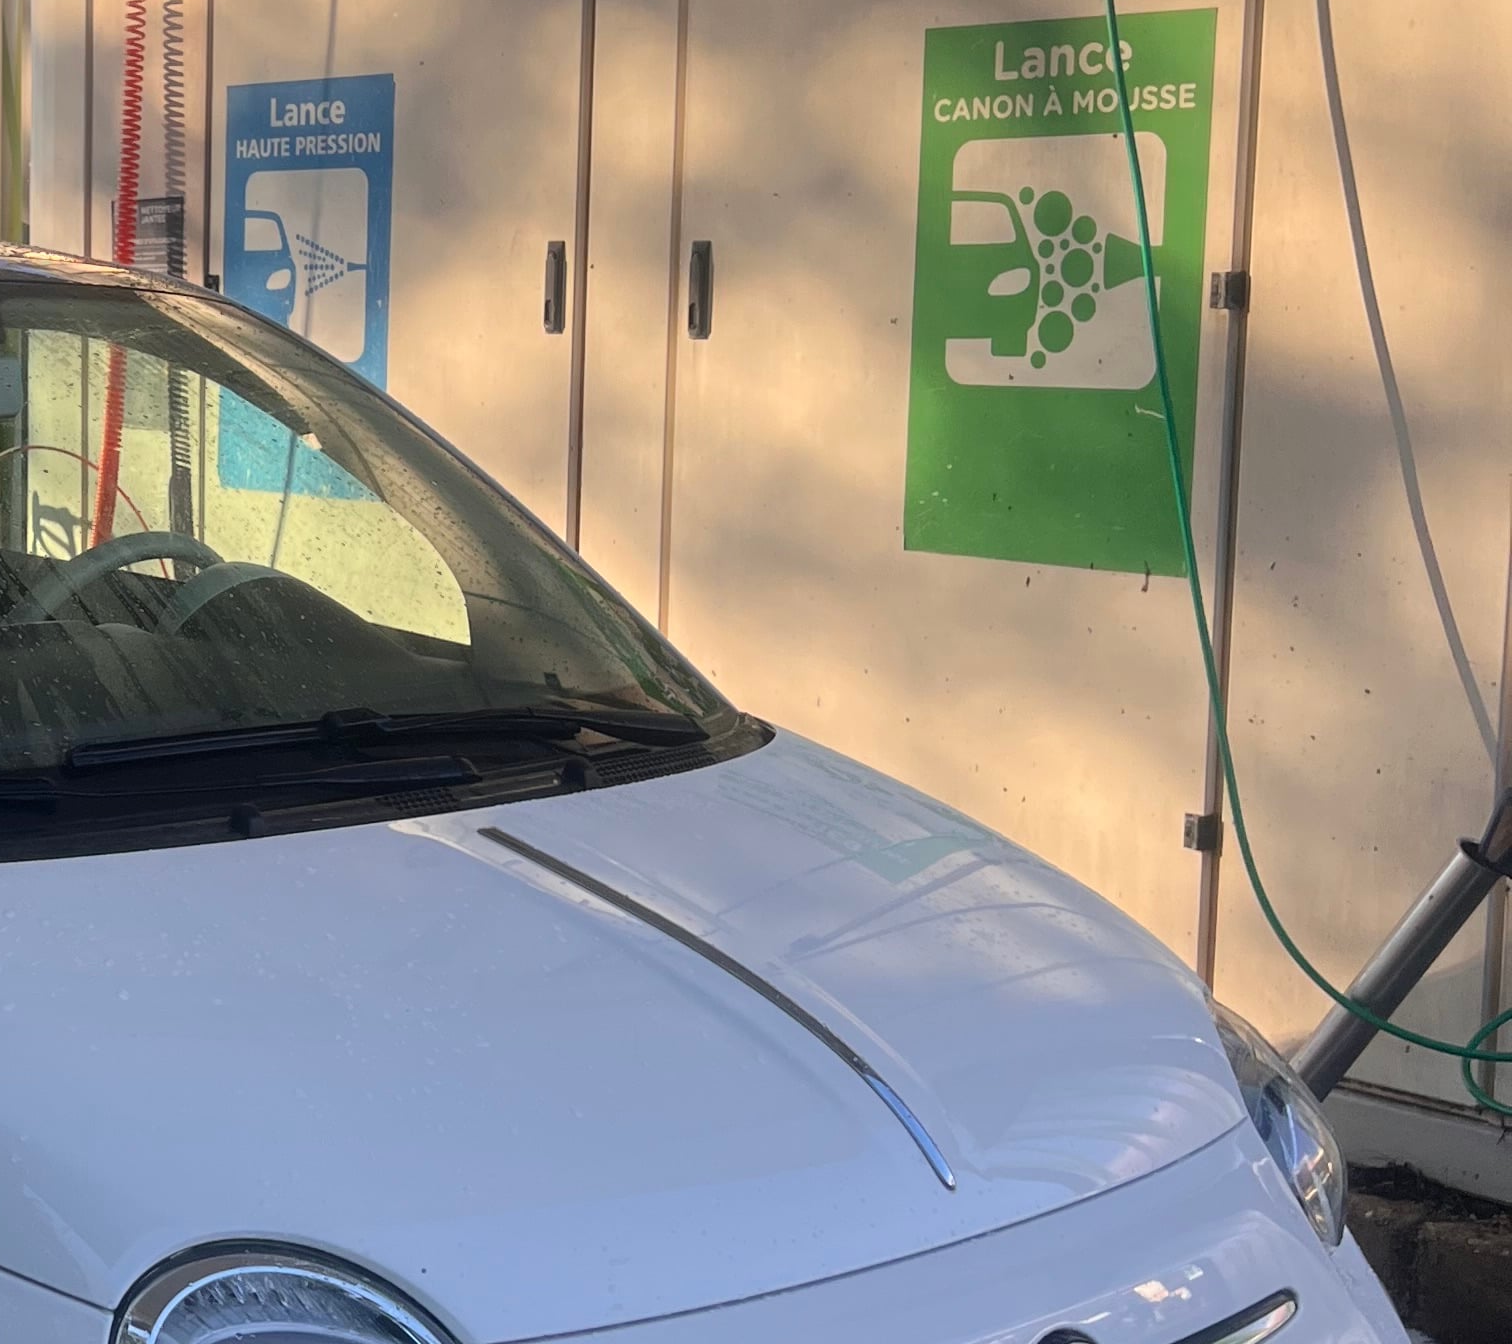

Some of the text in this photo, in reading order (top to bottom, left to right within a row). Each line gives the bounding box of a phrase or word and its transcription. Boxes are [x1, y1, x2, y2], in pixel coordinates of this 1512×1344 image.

[994, 40, 1133, 81] Lance
[270, 97, 346, 127] Lance
[934, 83, 1197, 122] CANON À MOUSSE
[236, 132, 381, 159] HAUTE PRESSION
